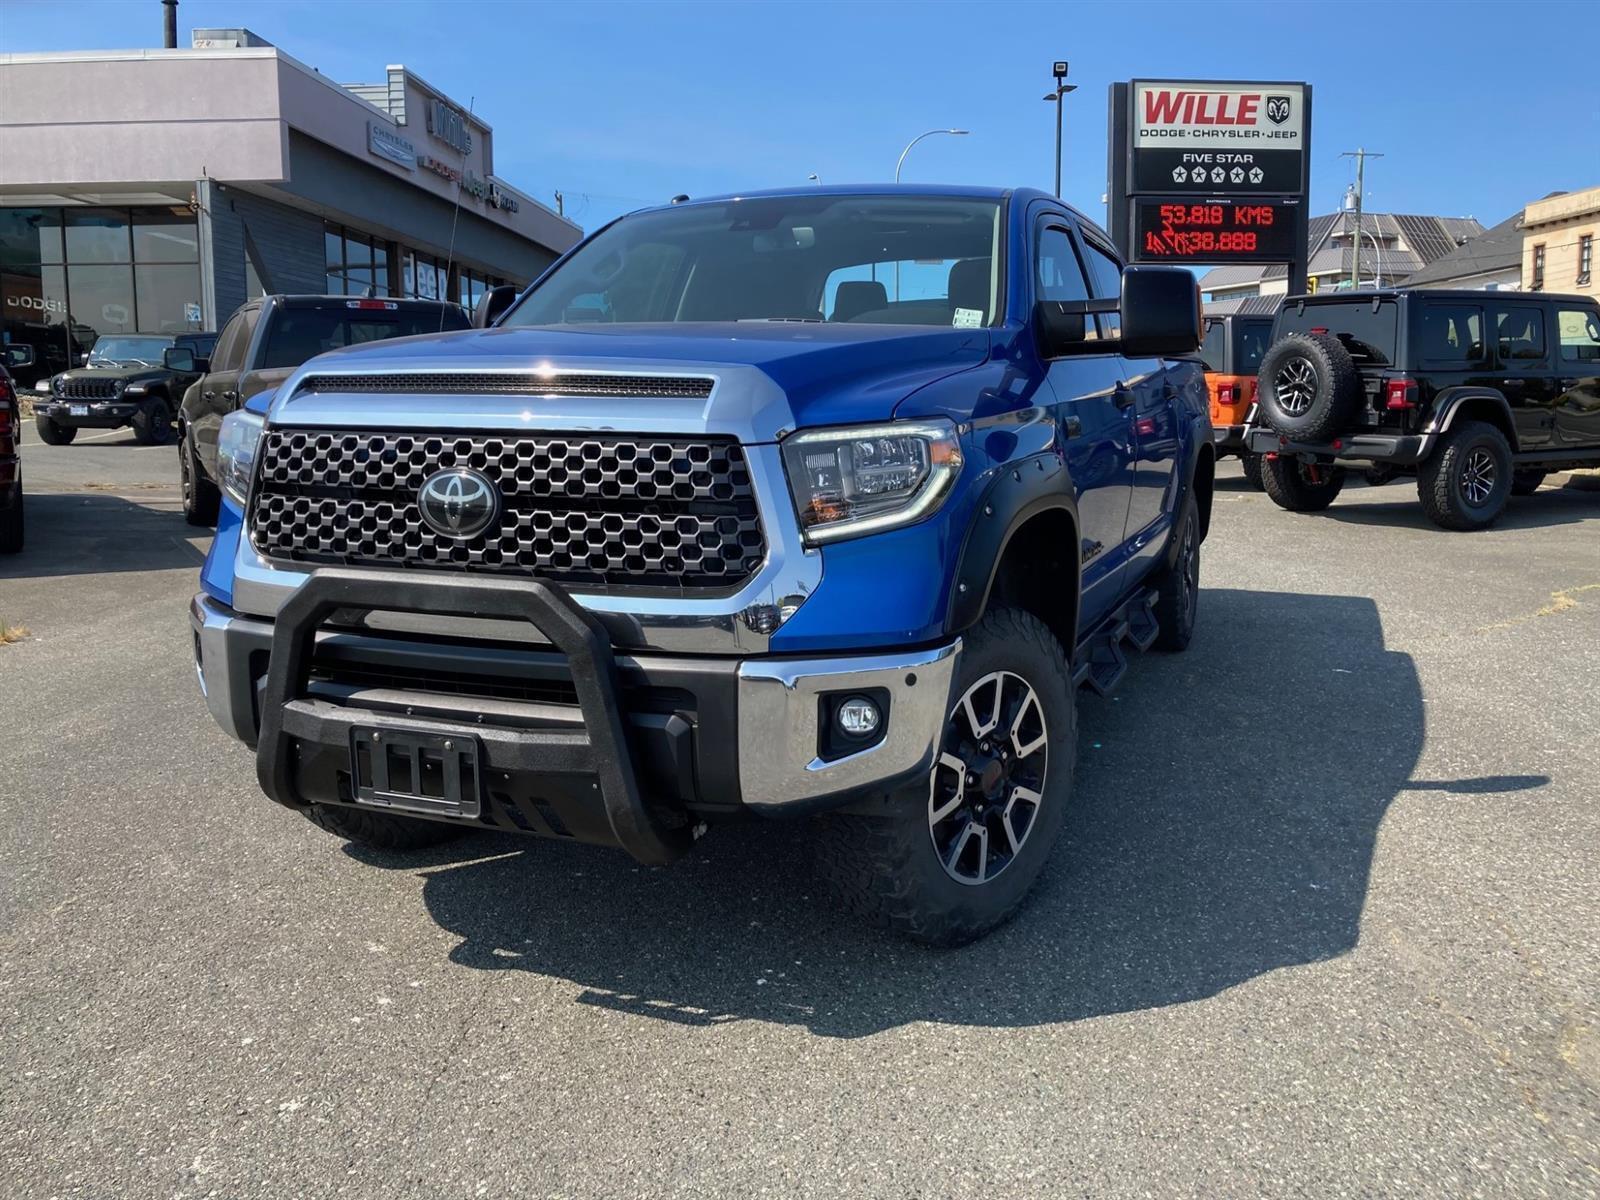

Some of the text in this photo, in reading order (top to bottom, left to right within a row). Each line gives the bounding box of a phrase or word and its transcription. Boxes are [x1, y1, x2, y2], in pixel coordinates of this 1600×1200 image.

[1145, 91, 1261, 125] WILLE
[1140, 129, 1298, 139] DODGE CHRYSLER JEEP
[1183, 154, 1254, 163] FIVE STAR
[1235, 206, 1273, 225] KMS
